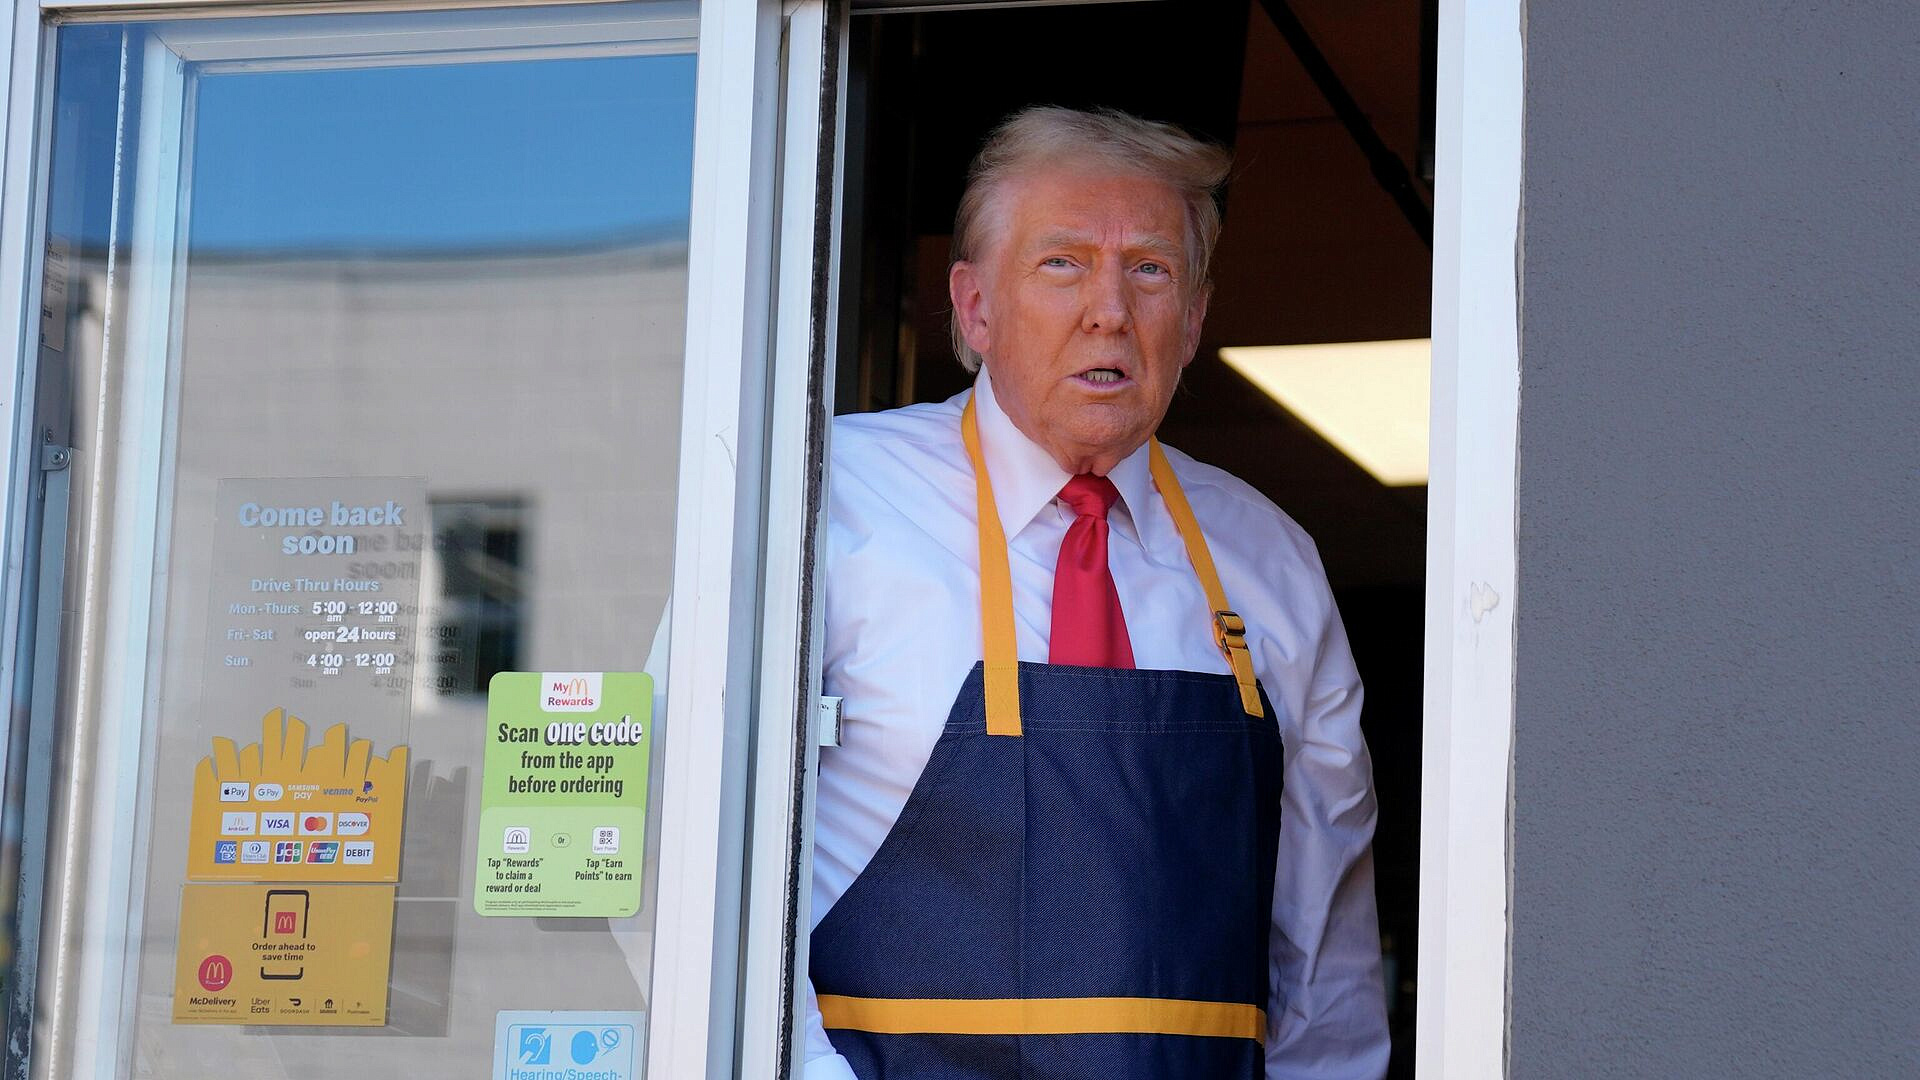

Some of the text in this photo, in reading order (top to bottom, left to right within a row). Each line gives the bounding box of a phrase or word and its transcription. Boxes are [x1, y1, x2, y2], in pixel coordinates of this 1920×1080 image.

[239, 500, 403, 527] Come back
[282, 534, 354, 555] soon
[251, 578, 380, 592] Drive Thru Hours
[229, 603, 255, 614] Mon
[264, 602, 300, 614] Thurs
[312, 601, 346, 615] 5:00
[358, 601, 398, 615] 12:00
[326, 614, 393, 622] am am
[304, 631, 335, 643] open
[335, 626, 360, 643] 24
[361, 628, 396, 640] hours
[224, 655, 249, 667] Sun
[307, 653, 343, 667] 4:00
[354, 653, 395, 667] 12:00
[323, 667, 391, 675] am am
[553, 682, 569, 694] My
[548, 696, 594, 706] Rewards
[498, 715, 643, 745] Scan one code
[521, 751, 614, 773] from the app
[509, 775, 623, 798] before ordering
[231, 787, 246, 798] Pay
[266, 788, 279, 797] Pay
[293, 792, 312, 800] pay
[265, 819, 289, 828] VISA
[558, 836, 565, 844] Or
[222, 844, 237, 852] AM
[277, 848, 300, 856] JCB
[346, 849, 371, 857] DEBIT
[221, 852, 236, 860] EX
[488, 857, 544, 869] Tap “Rewards”
[586, 858, 623, 869] Tap “Earn
[496, 872, 504, 880] to
[505, 870, 526, 880] claim
[575, 870, 632, 881] Points” to earn
[486, 883, 541, 893] reward or deal
[252, 942, 316, 951] Order ahead to
[283, 952, 304, 961] time
[189, 997, 237, 1007] McDelivery
[251, 998, 270, 1006] Uber
[250, 1005, 270, 1014] Eats
